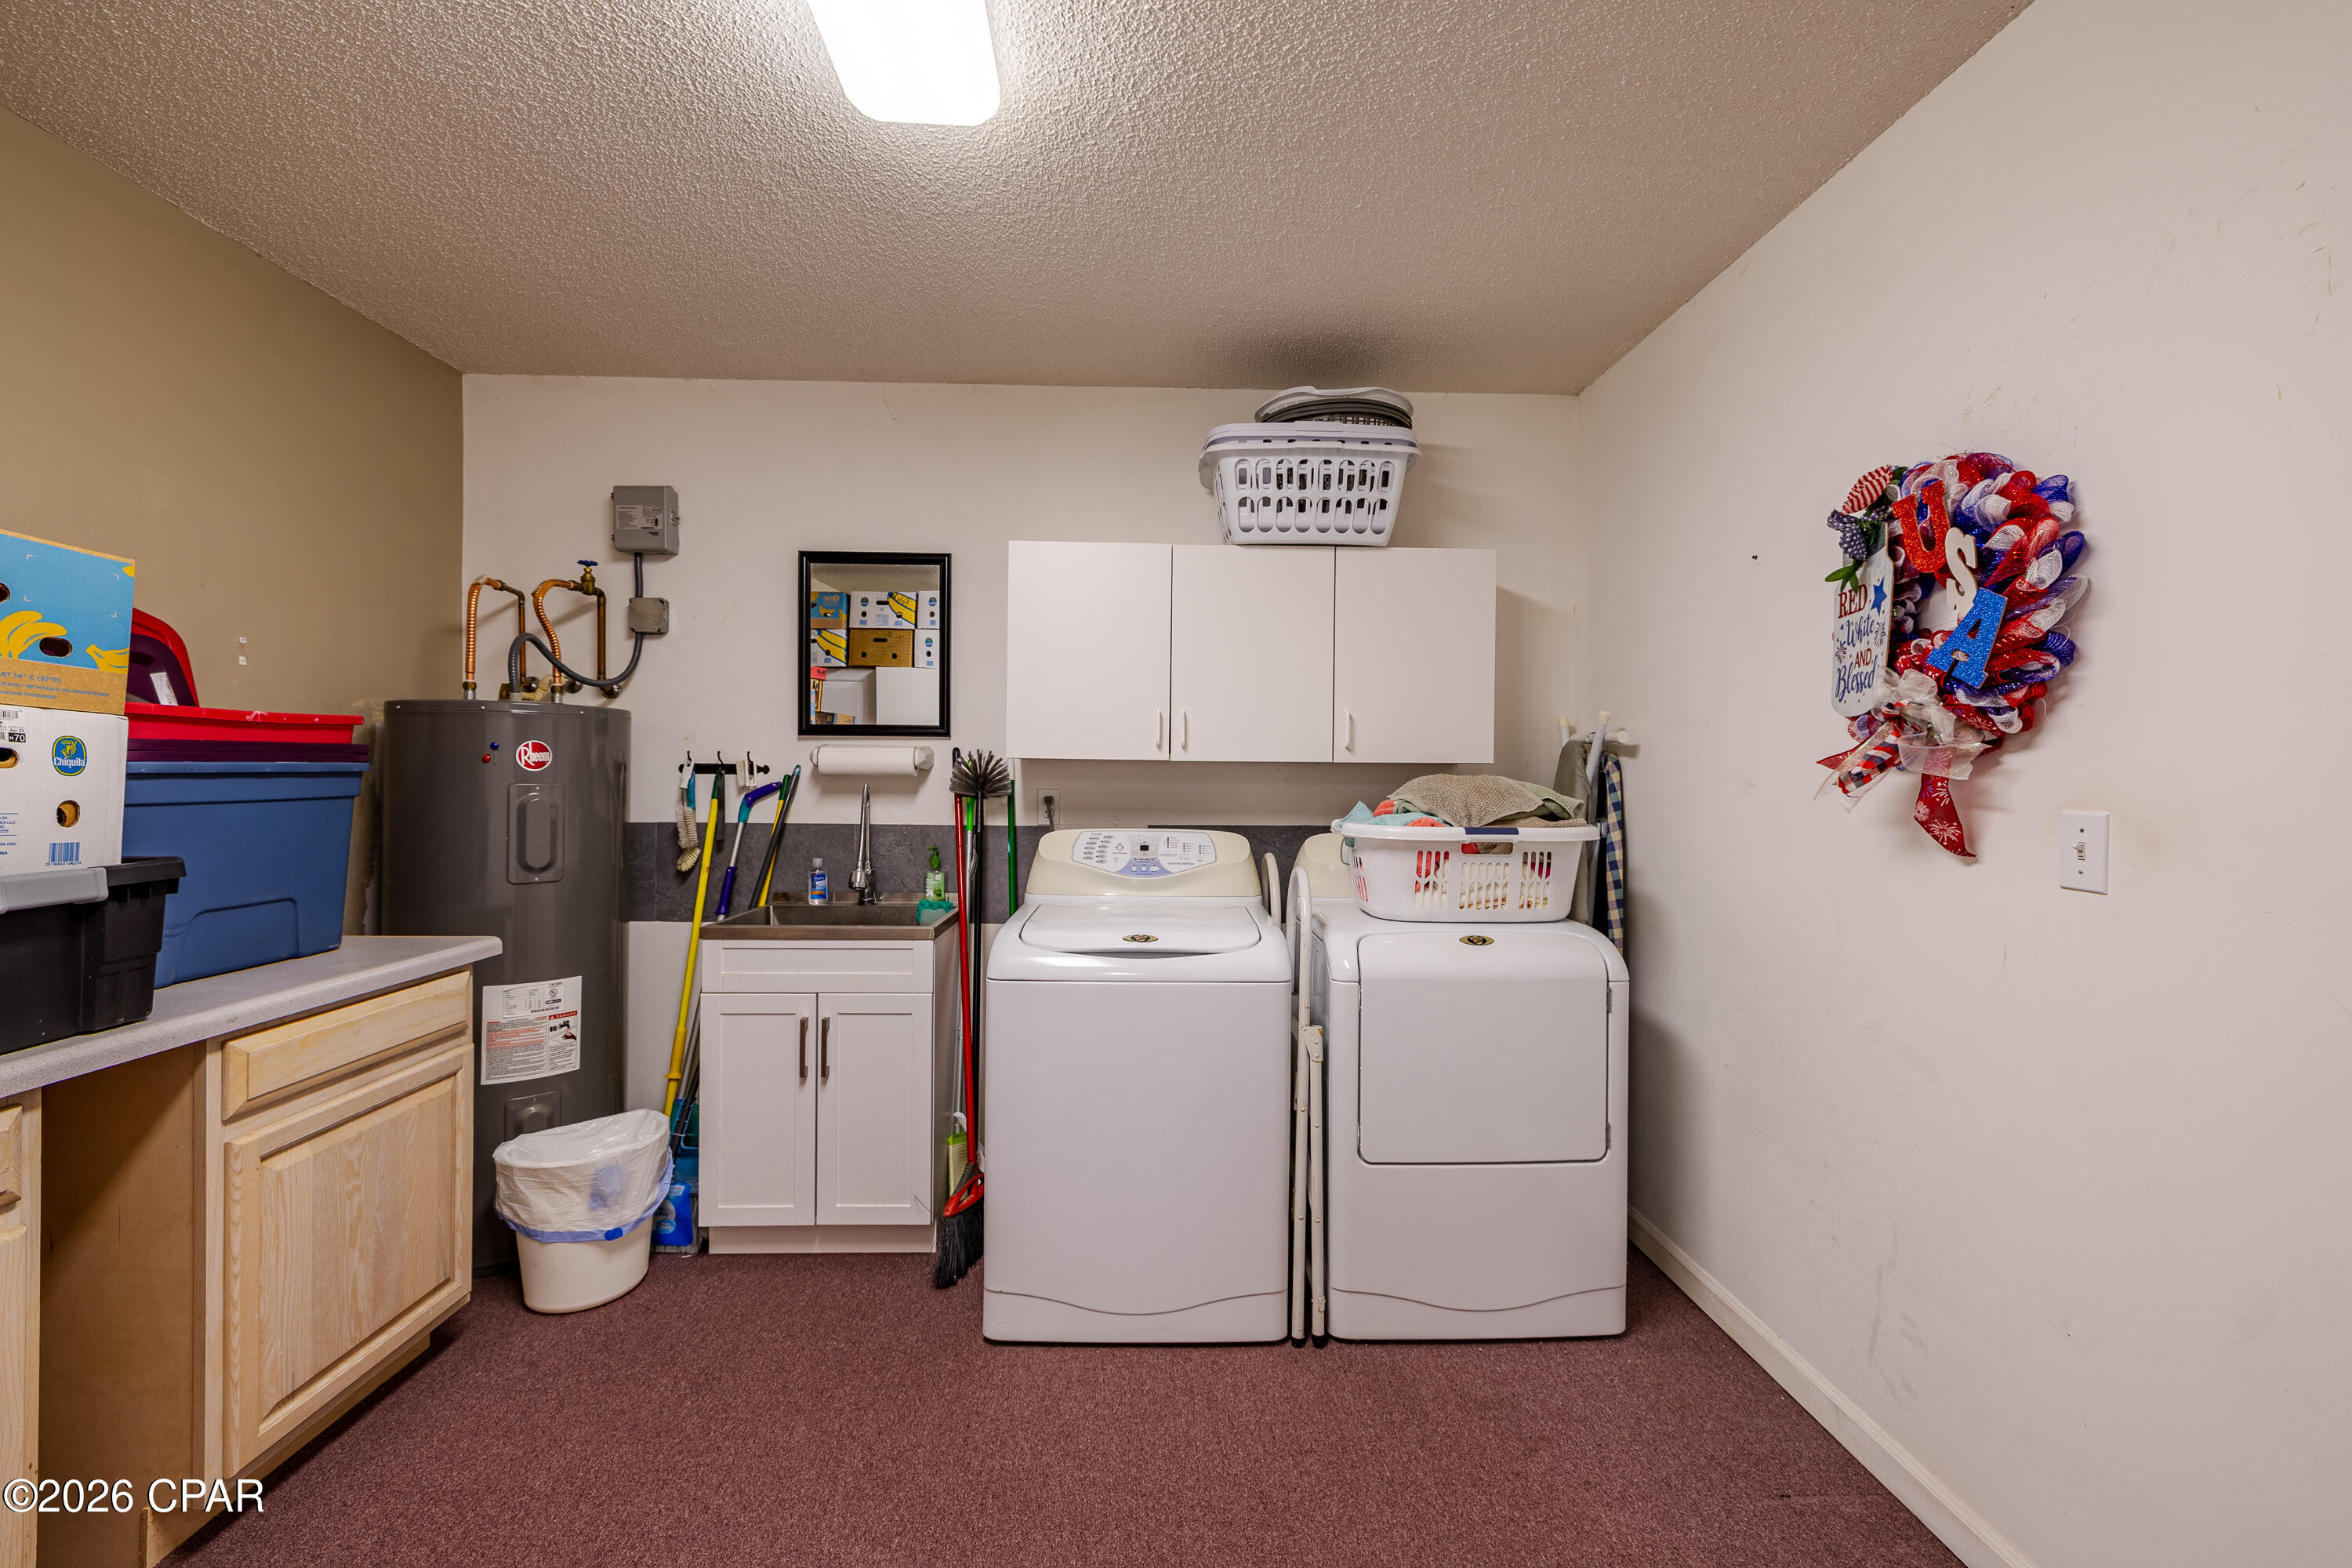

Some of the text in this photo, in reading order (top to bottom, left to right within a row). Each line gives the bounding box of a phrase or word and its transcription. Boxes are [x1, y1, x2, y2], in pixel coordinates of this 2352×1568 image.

[1892, 479, 2009, 689] USA
[1838, 584, 1868, 619] RED
[1846, 613, 1875, 648] White
[1854, 648, 1872, 668] AND
[1835, 655, 1878, 702] Blessed
[13, 734, 25, 742] 70
[53, 757, 85, 769] Chiquita
[521, 741, 550, 767] Rheem
